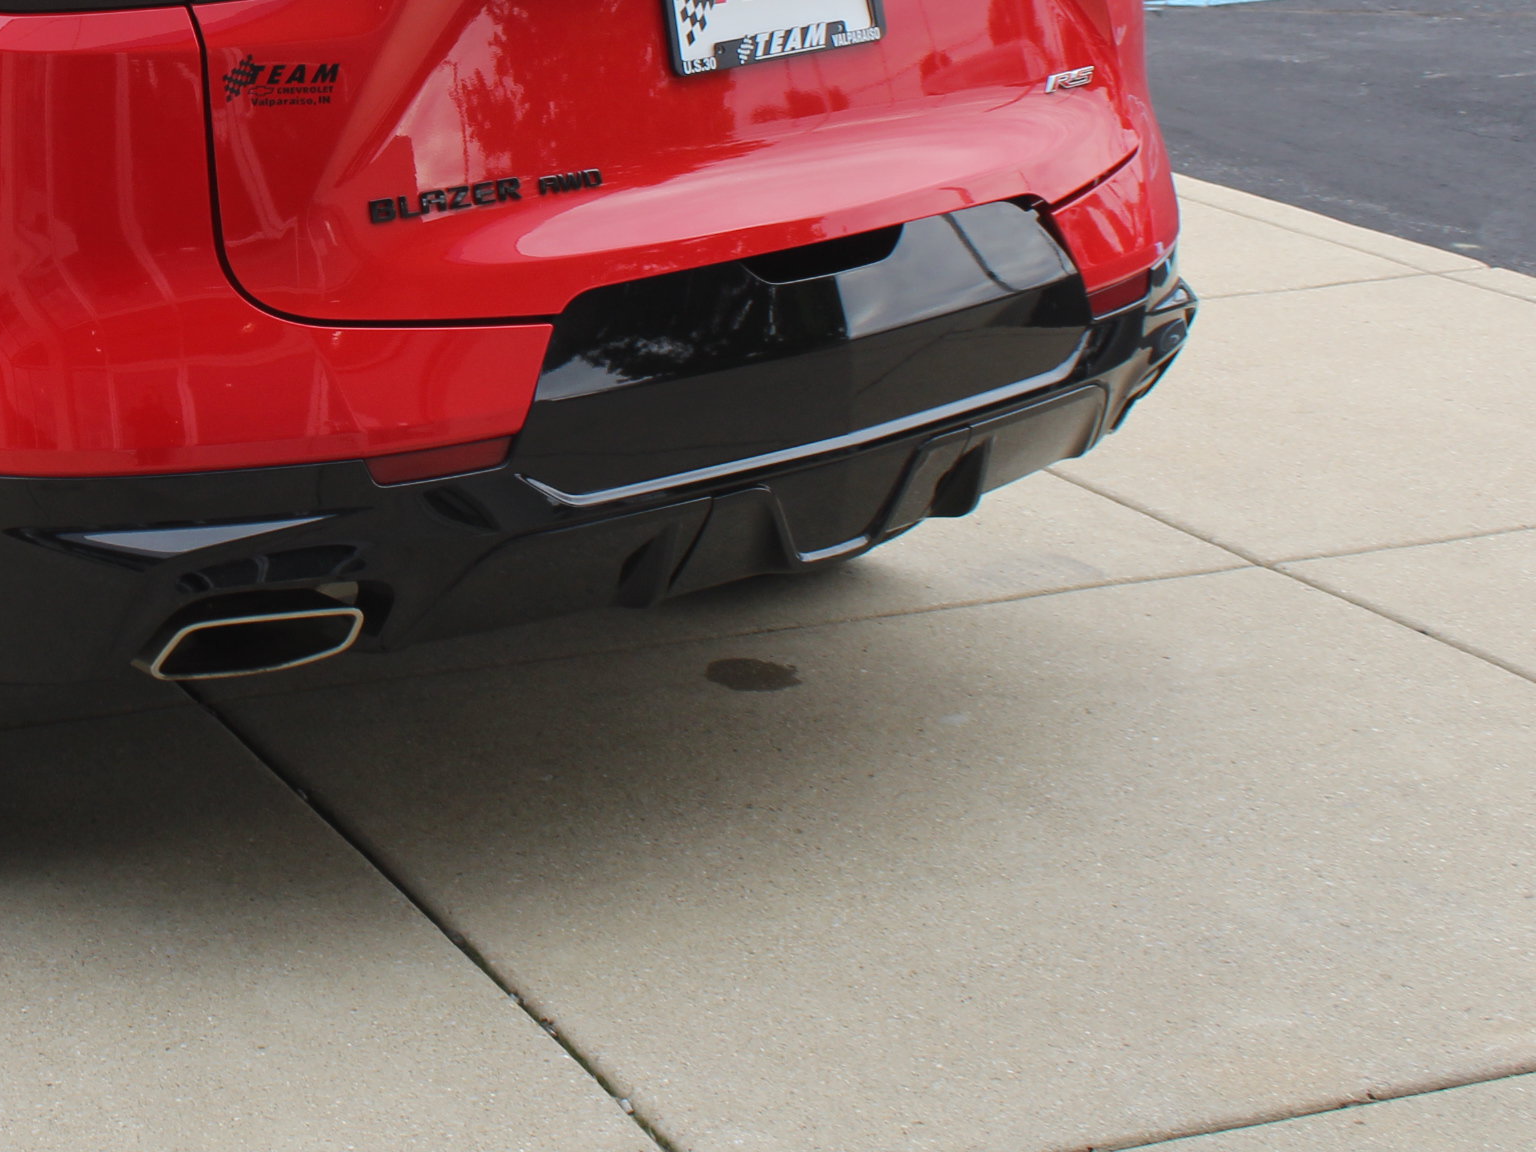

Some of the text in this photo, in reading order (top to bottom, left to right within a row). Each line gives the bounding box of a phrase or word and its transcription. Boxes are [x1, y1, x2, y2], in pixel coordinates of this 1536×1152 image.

[755, 22, 828, 57] TEAM
[831, 26, 881, 47] VALPARAISO
[251, 63, 340, 84] TEAM
[1044, 65, 1095, 94] RS
[251, 95, 331, 107] Valparaiso, IN
[277, 86, 334, 95] CHEVROLET
[369, 167, 604, 225] BLAZER AWD
